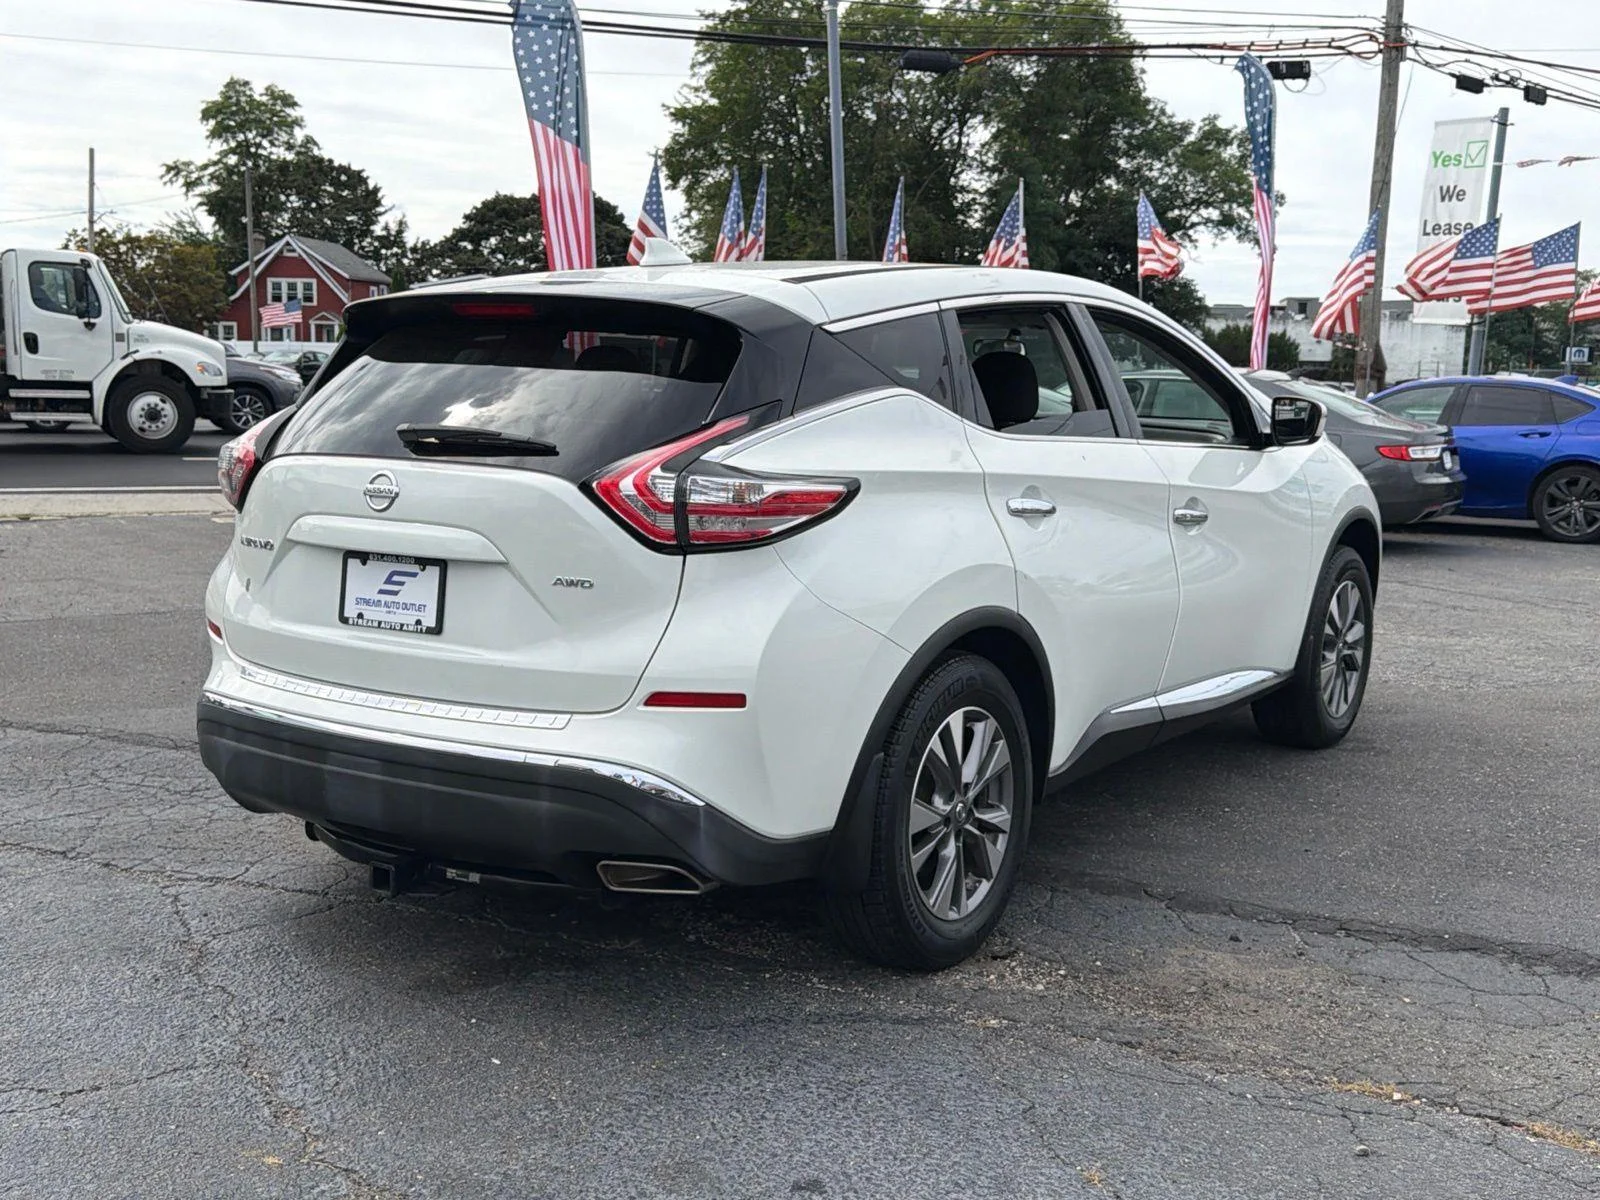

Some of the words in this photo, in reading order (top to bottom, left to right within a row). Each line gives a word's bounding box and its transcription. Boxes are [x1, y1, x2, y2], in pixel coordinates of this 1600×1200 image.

[1432, 150, 1463, 168] Yes
[1439, 185, 1467, 202] We
[1422, 219, 1474, 237] Lease
[365, 486, 395, 496] NISSAN
[551, 575, 595, 589] AWD
[354, 597, 383, 608] STREAM
[383, 601, 401, 610] AUTO
[401, 602, 427, 613] OUTLET
[348, 617, 379, 628] STREAM
[380, 621, 401, 630] AUTO
[402, 623, 427, 633] AMITY
